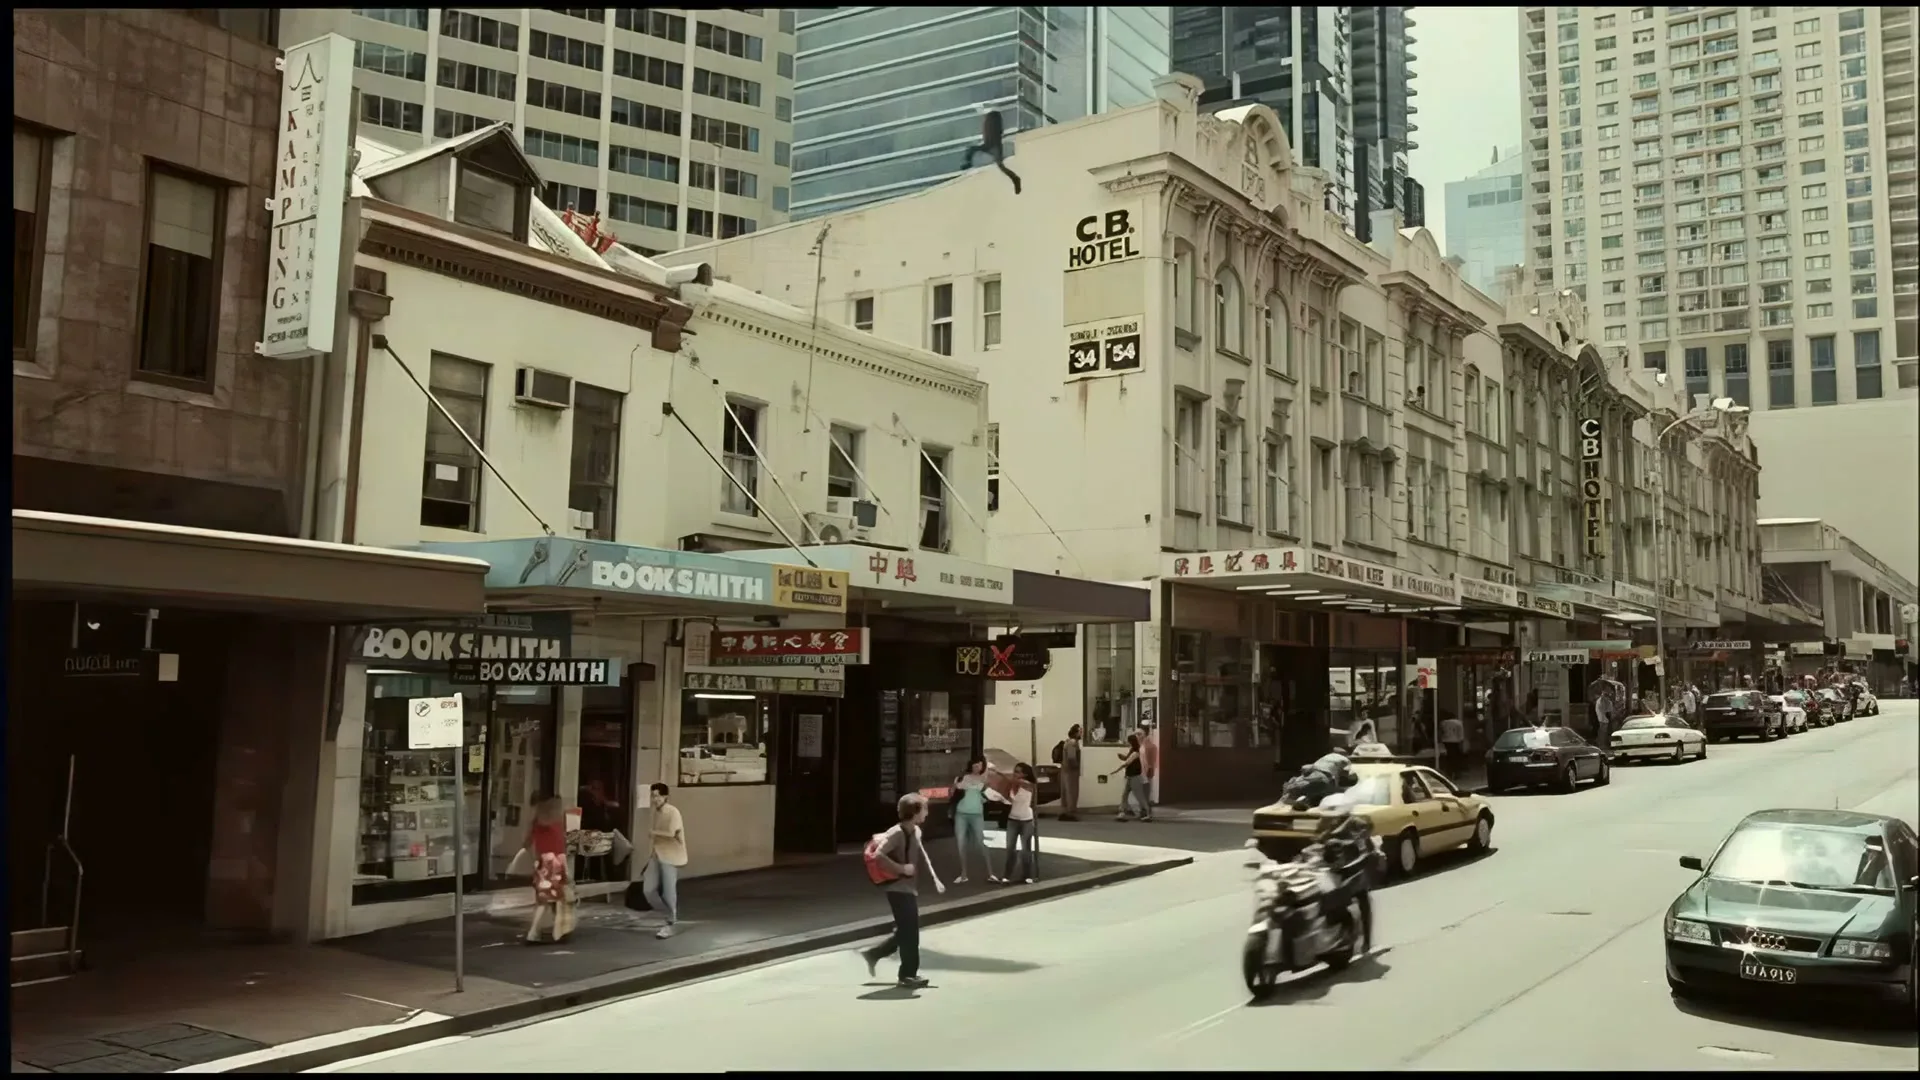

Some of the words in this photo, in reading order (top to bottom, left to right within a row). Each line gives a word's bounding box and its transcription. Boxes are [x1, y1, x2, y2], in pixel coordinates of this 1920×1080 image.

[1076, 209, 1135, 243] C.B.
[1069, 236, 1139, 268] HOTEL
[592, 560, 763, 601] BOOKSMITH
[363, 627, 560, 660] BOOKSMITH
[480, 662, 605, 682] BOOKSMITH
